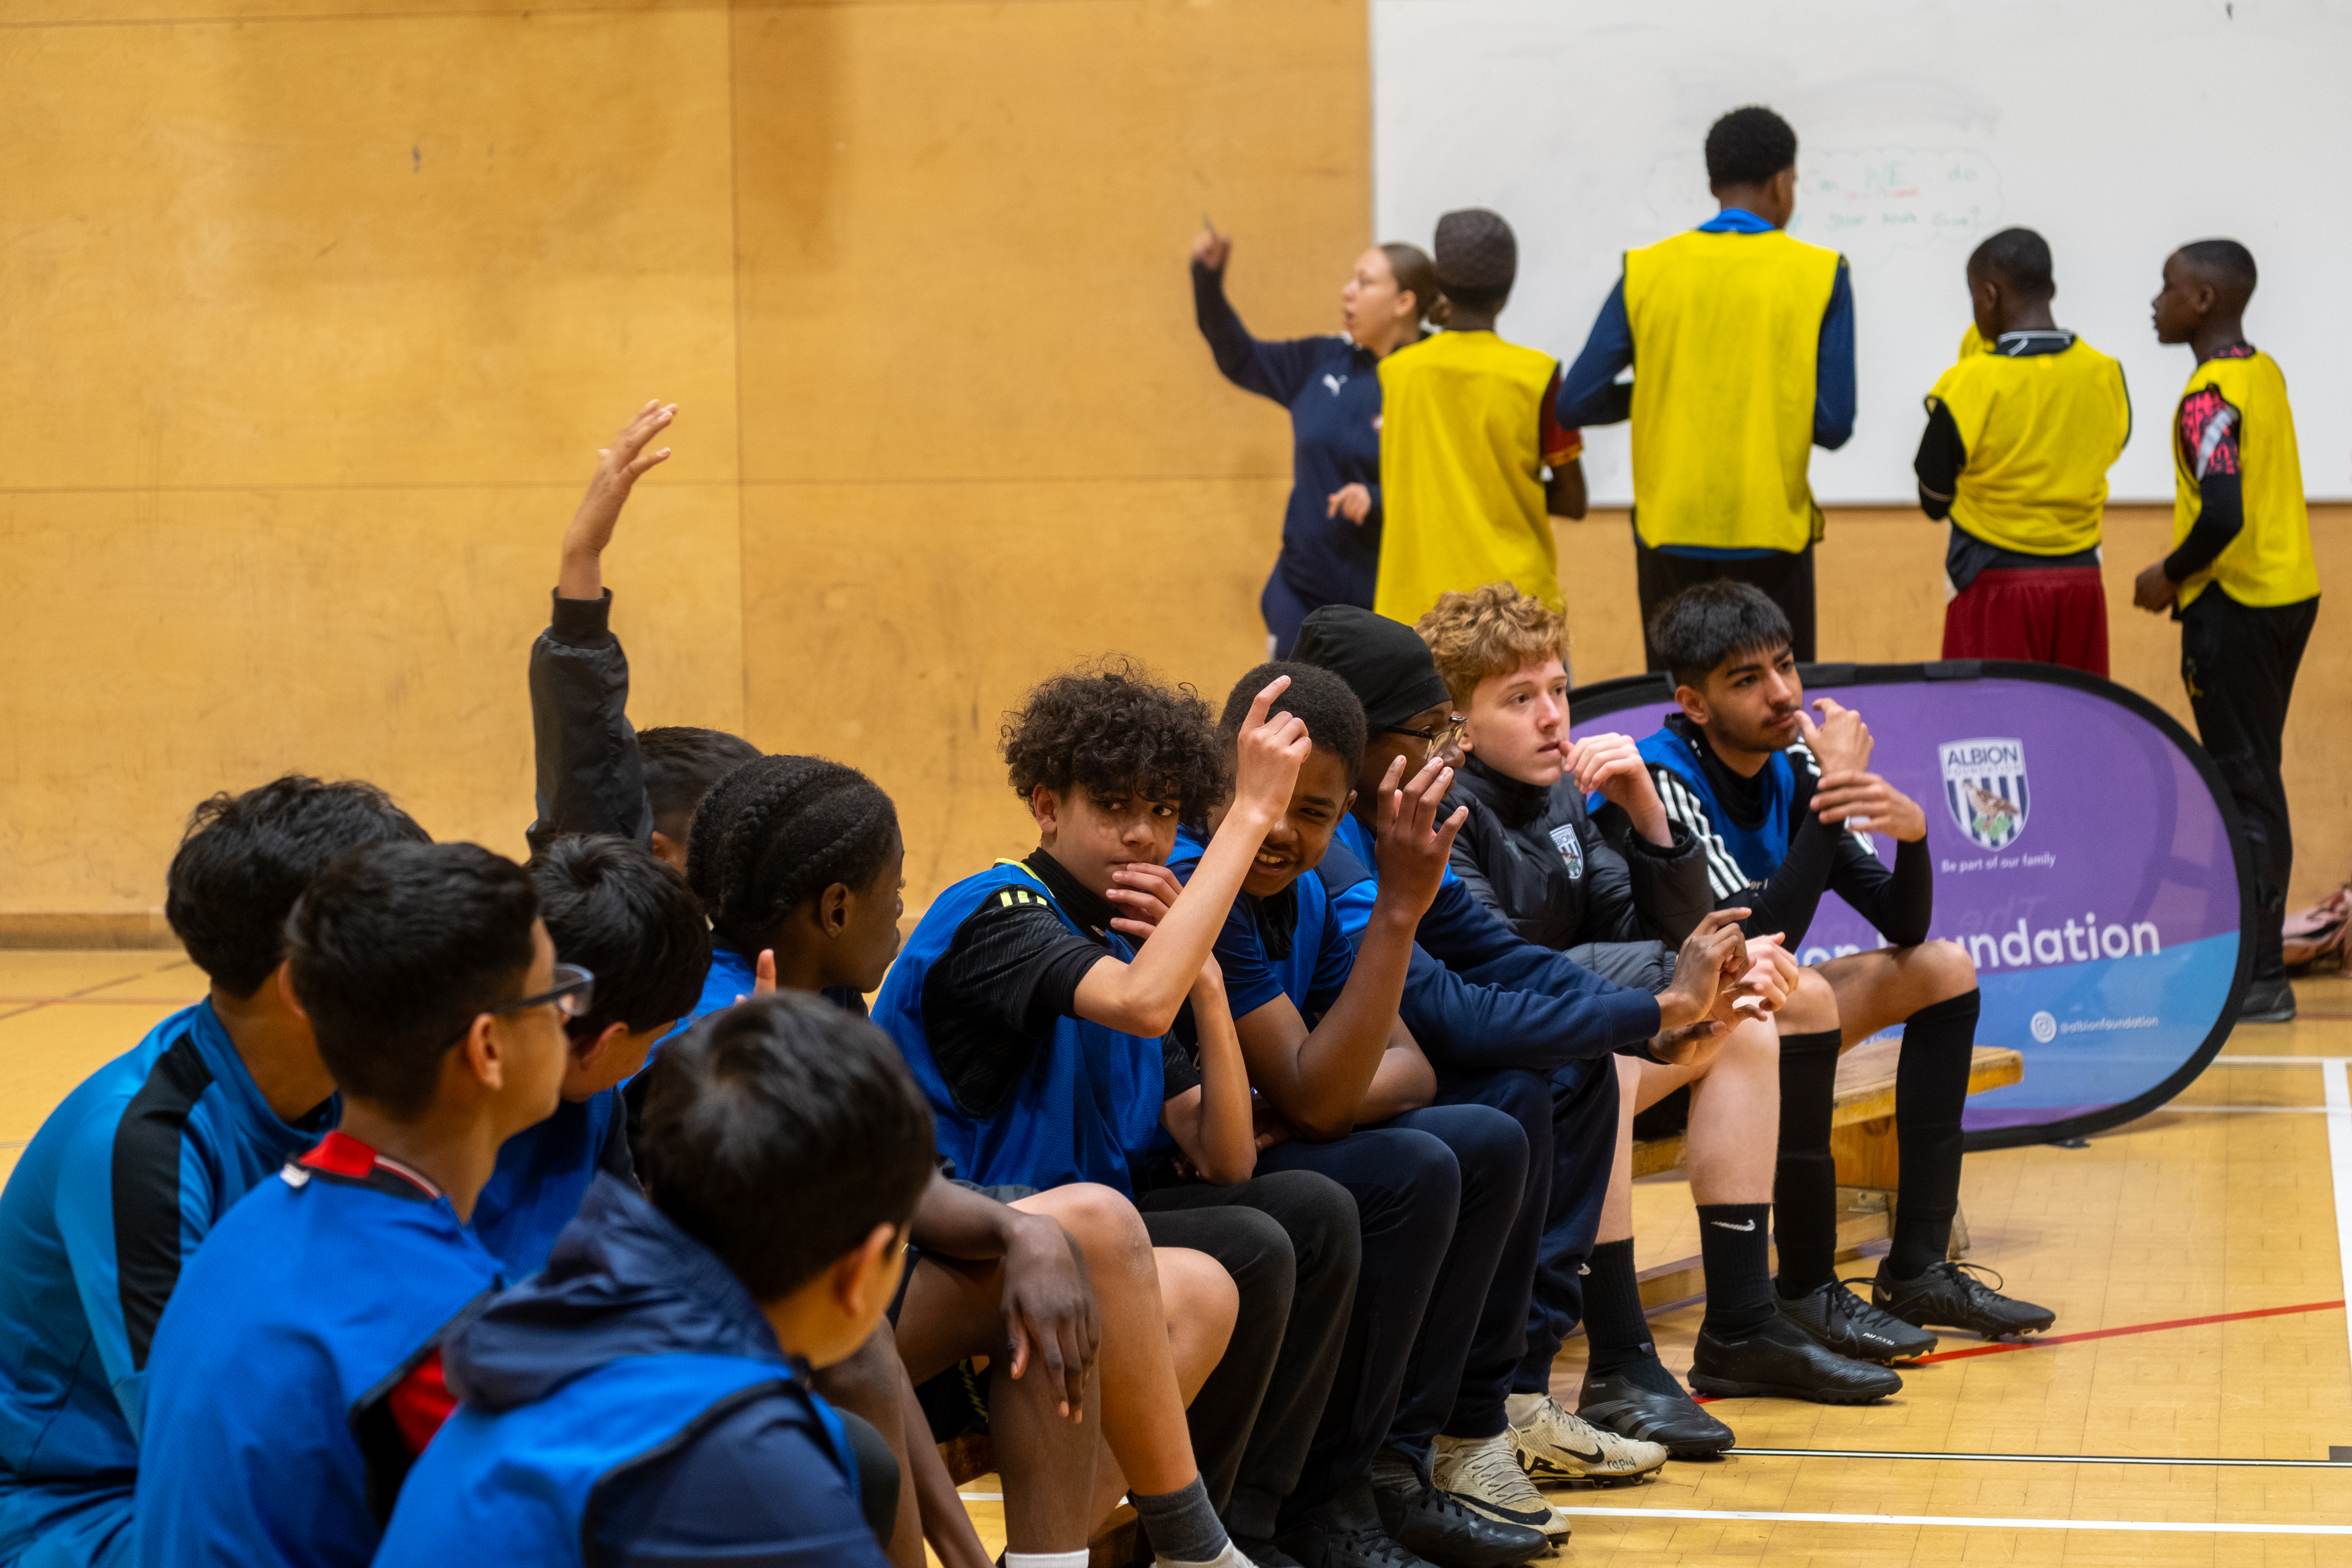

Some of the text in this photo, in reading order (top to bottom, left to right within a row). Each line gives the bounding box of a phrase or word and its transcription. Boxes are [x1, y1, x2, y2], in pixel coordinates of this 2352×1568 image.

[1948, 746, 2018, 766] ALBION
[1941, 852, 2056, 874] Be part of our family
[1607, 1456, 1637, 1470] rapid
